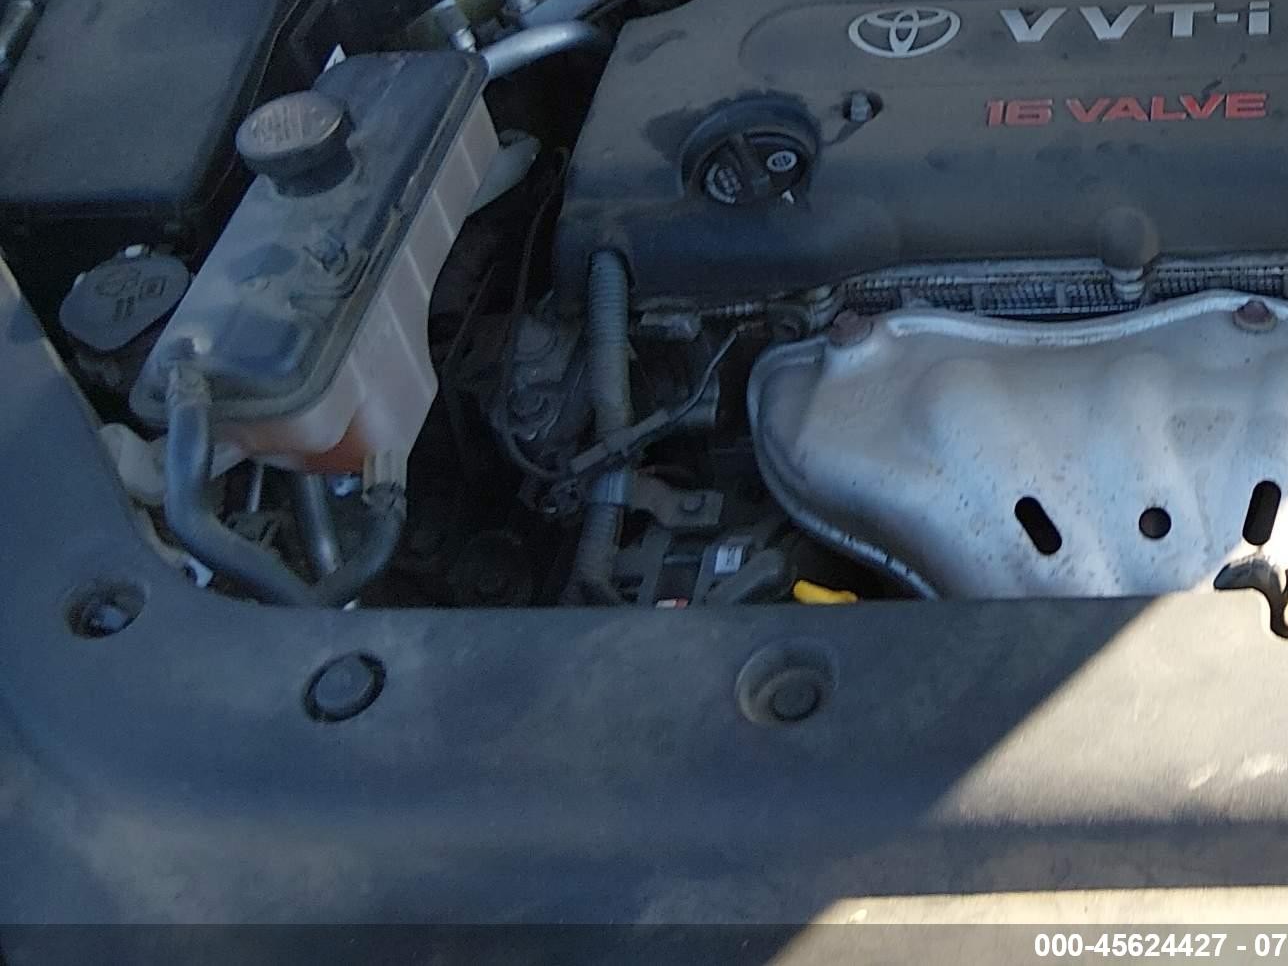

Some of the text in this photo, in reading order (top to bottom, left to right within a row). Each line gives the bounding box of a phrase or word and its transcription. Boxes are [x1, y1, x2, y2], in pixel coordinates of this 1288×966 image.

[1001, 1, 1270, 43] VVT-i
[985, 92, 1269, 127] 16 VALVE
